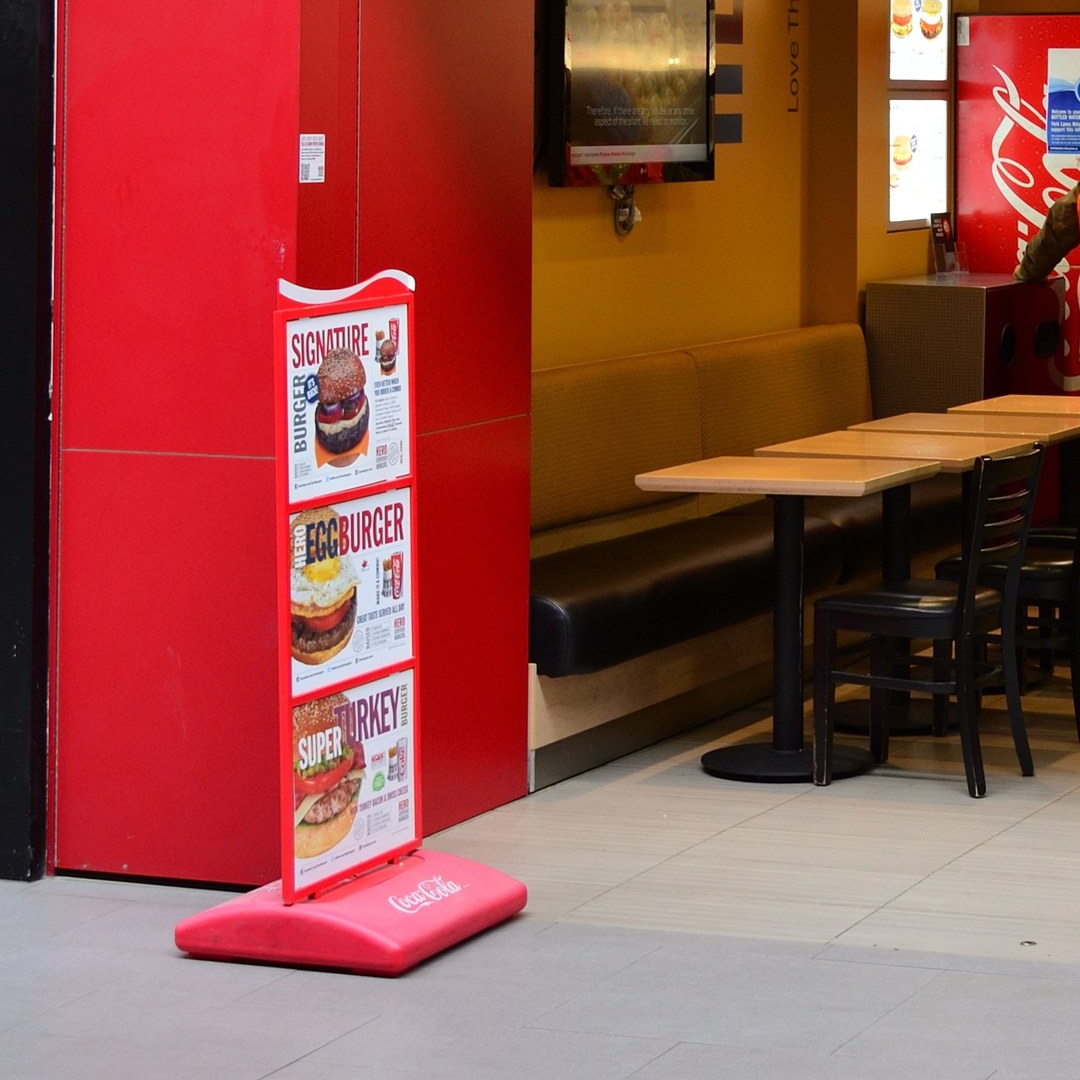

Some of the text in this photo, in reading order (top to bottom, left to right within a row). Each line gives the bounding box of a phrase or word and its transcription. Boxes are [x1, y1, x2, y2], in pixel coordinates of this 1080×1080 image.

[788, 54, 799, 113] Love
[292, 323, 369, 369] SIGNATURE
[293, 374, 307, 453] BURGER
[294, 524, 306, 570] HERO
[306, 502, 404, 564] EGG BURGER
[357, 614, 367, 624] GREAT
[368, 611, 378, 620] TASTE
[379, 607, 391, 618] SERVED
[334, 686, 400, 745] TURKEY
[299, 726, 342, 770] SUPER
